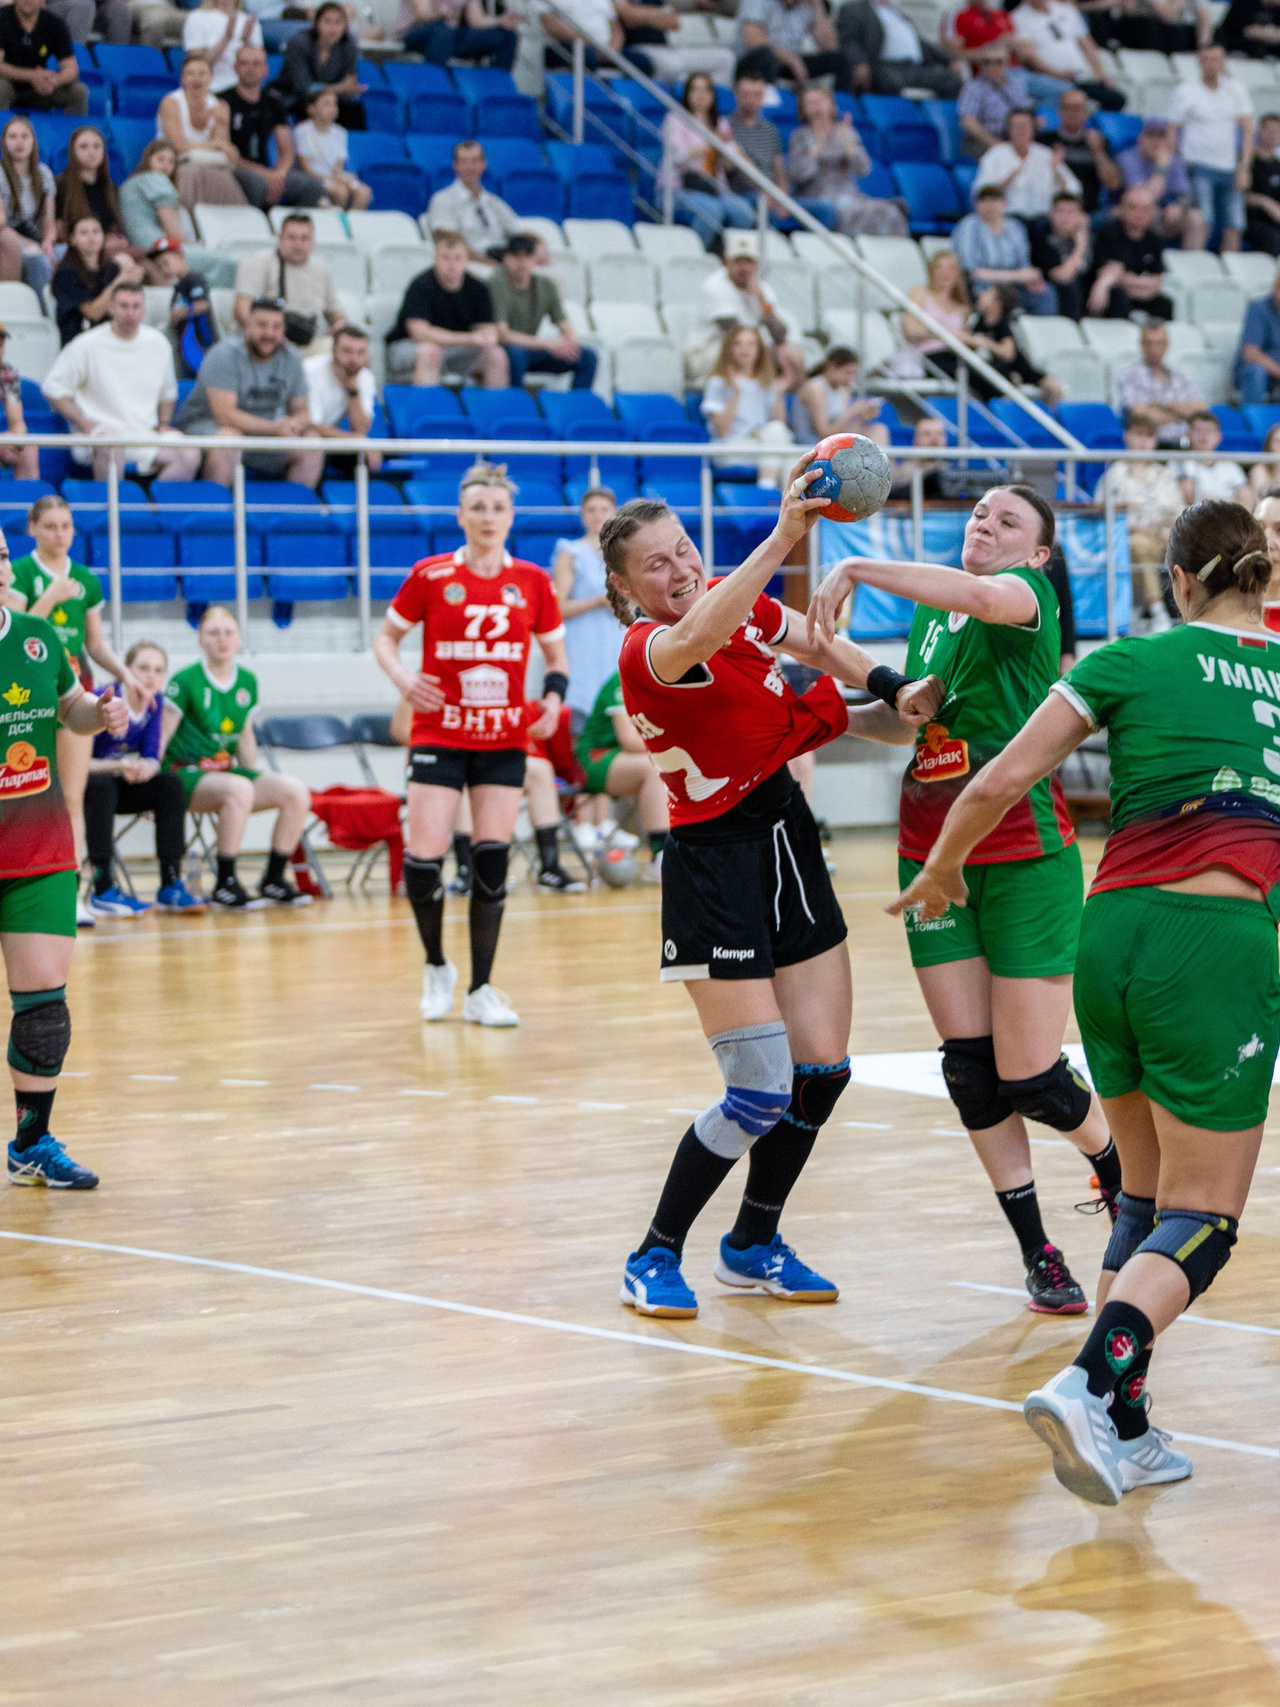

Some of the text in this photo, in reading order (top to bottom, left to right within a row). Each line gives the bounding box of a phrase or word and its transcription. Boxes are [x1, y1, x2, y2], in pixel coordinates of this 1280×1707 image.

[464, 604, 510, 639] 73
[919, 619, 943, 664] 15
[7, 721, 34, 737] ДСК
[915, 919, 956, 932] ГОМЕЛЯ
[713, 946, 755, 961] Kempa
